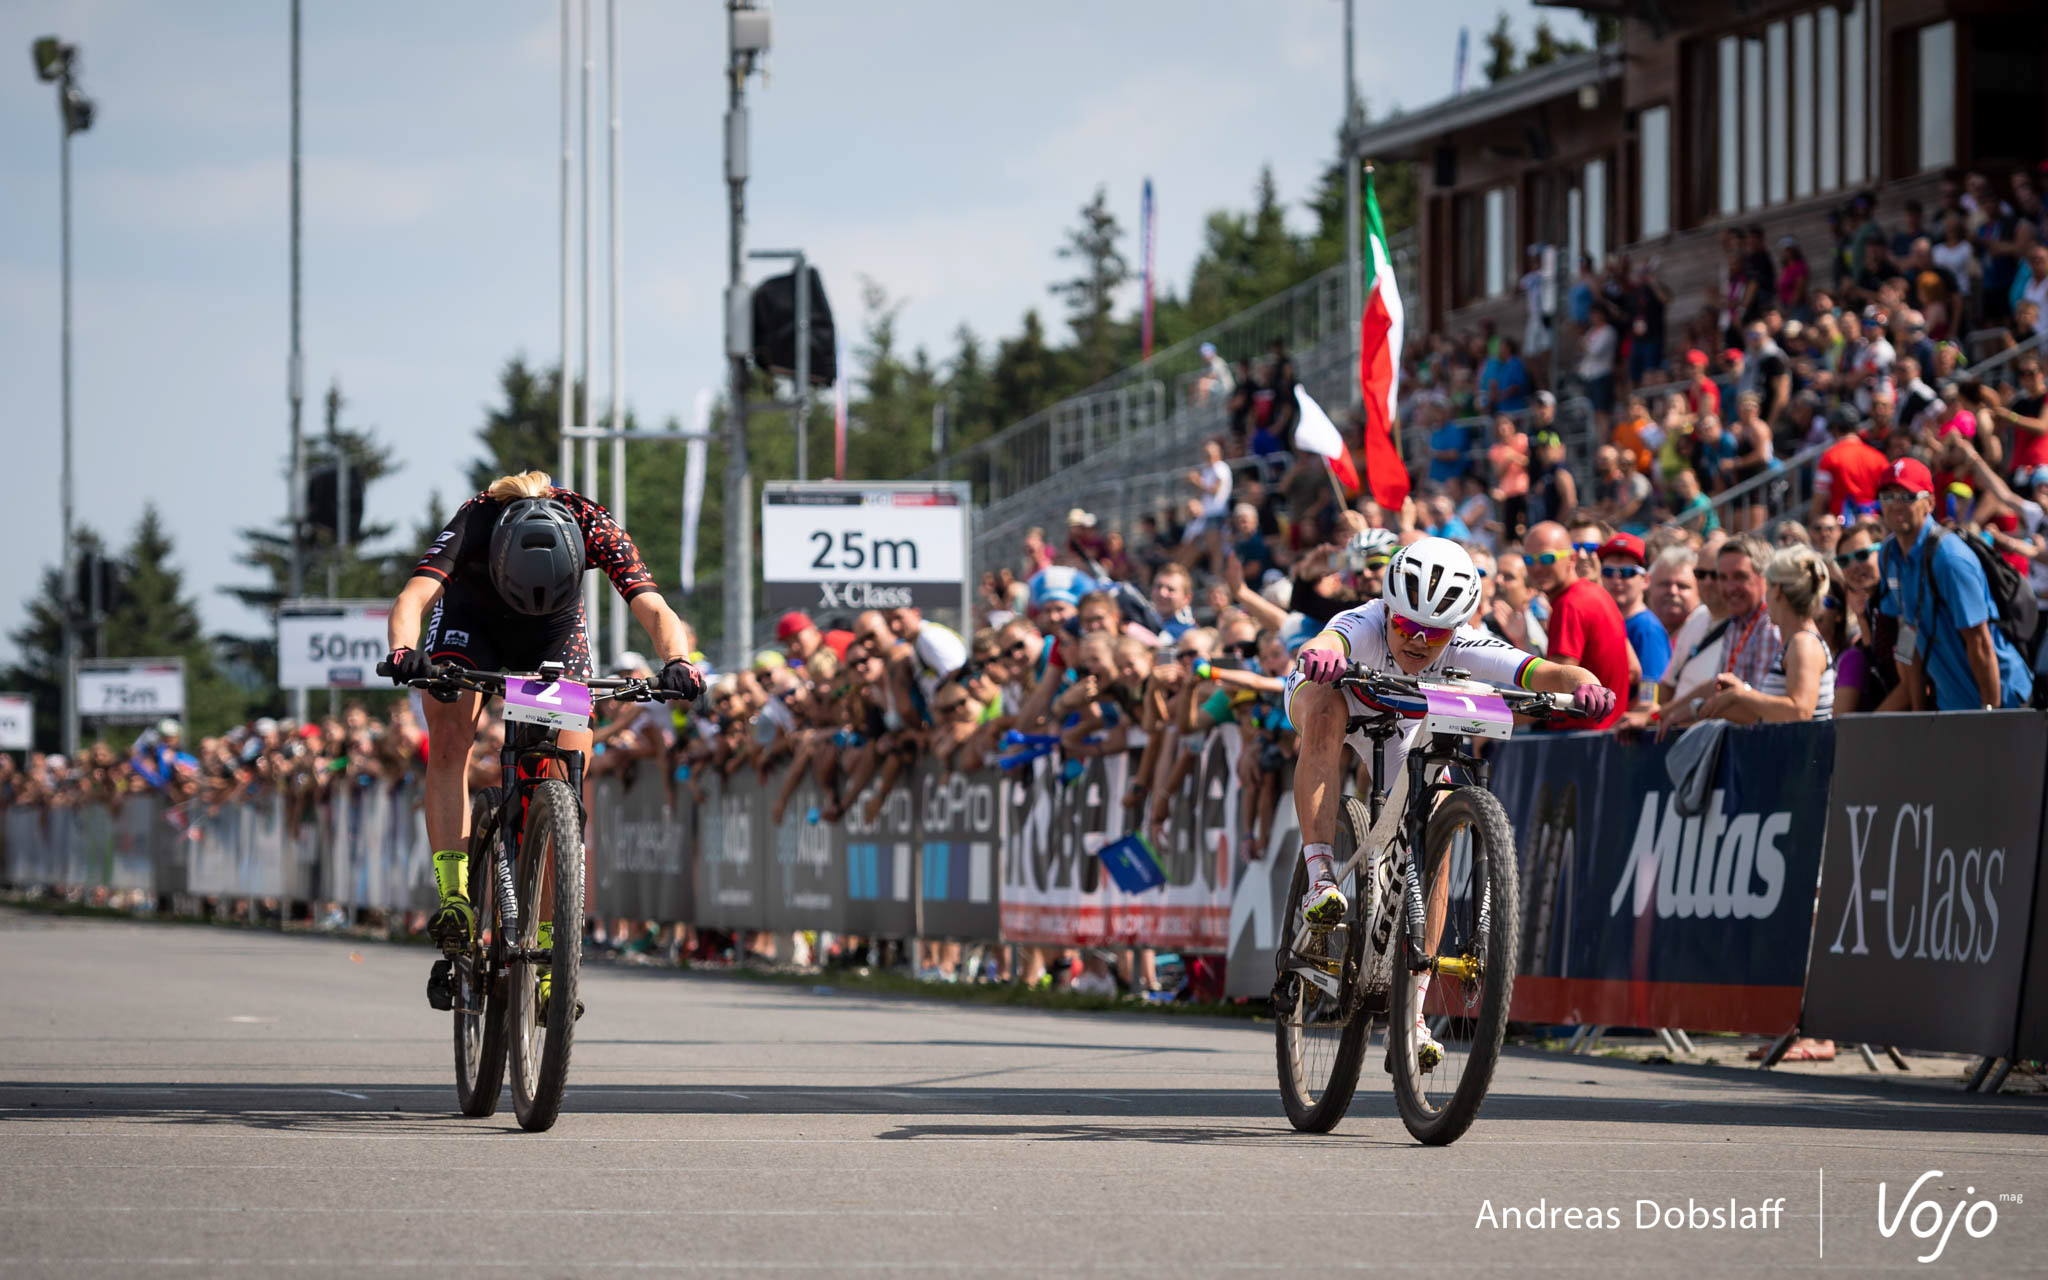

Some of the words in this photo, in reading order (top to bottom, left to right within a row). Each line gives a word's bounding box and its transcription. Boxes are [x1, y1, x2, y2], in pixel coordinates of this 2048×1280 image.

[810, 531, 918, 570] 25m
[819, 583, 912, 608] X-Class
[308, 633, 382, 661] 50m
[1449, 636, 1515, 650] GHOS
[535, 681, 562, 706] 2
[1456, 696, 1477, 713] 1
[921, 771, 994, 834] GoPro
[1611, 788, 1793, 920] Mitas
[499, 858, 519, 919] ROCKSHOX
[1406, 863, 1426, 925] ROCKSHOX
[1830, 803, 2006, 964] X-Class
